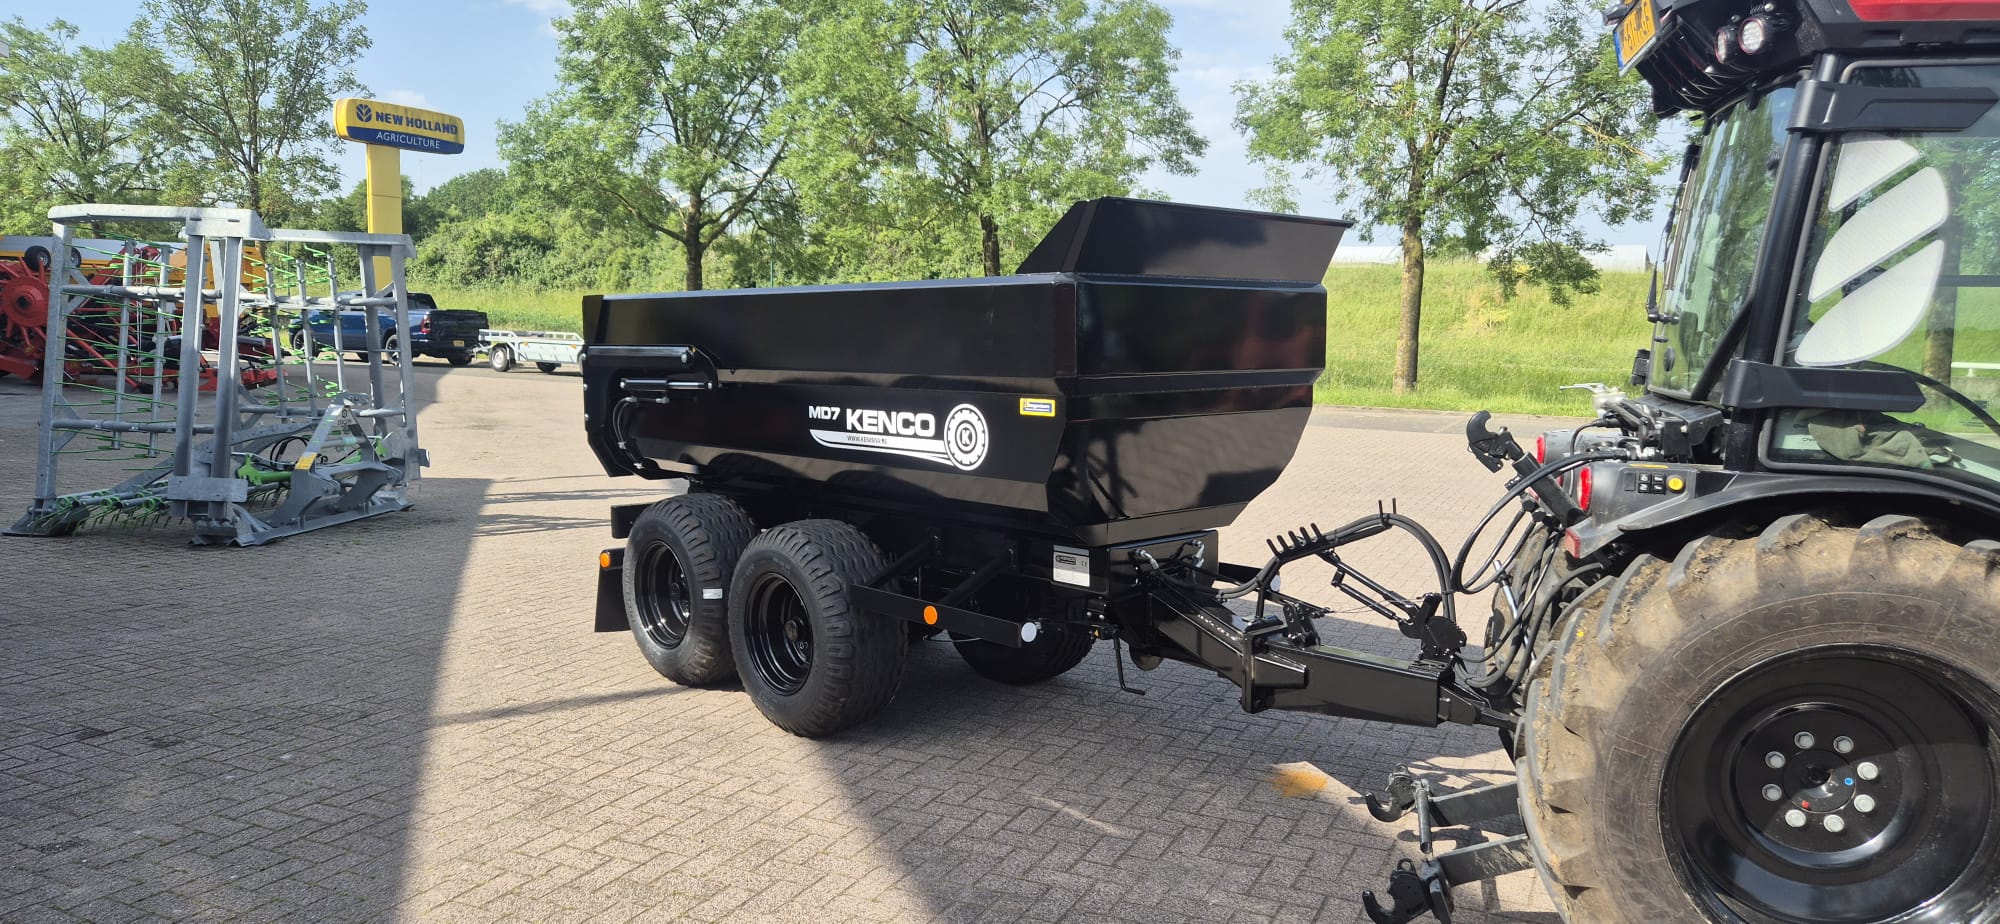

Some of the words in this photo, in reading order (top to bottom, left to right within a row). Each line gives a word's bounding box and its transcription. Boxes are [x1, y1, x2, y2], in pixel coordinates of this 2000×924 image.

[375, 111, 403, 126] NEW
[406, 116, 458, 135] HOLLAND
[376, 131, 441, 149] AGRICULTURE
[808, 405, 841, 420] MD7
[846, 408, 936, 437] KENCO
